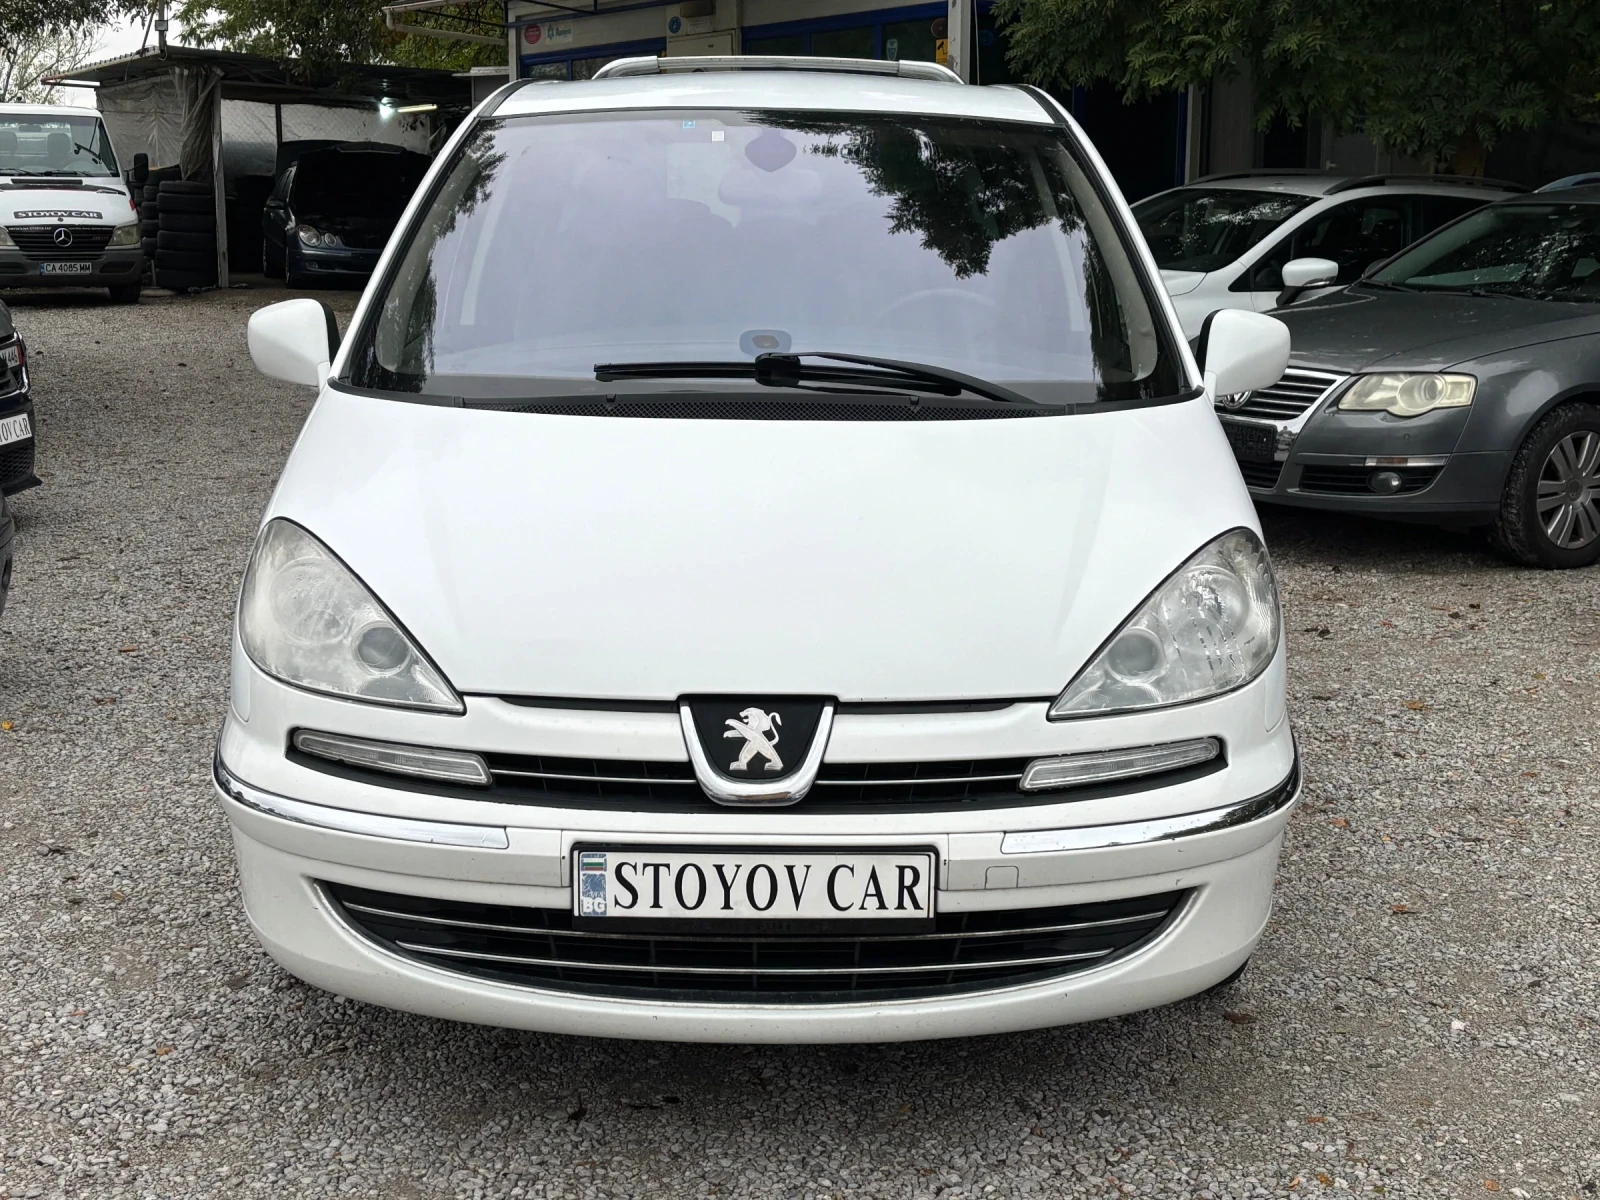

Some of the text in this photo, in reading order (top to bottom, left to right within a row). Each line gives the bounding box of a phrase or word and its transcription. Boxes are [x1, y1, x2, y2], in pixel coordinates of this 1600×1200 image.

[45, 263, 57, 273] CA
[79, 263, 91, 273] MM
[13, 417, 31, 438] CAR
[614, 861, 925, 912] STOYOV CAR
[582, 897, 607, 914] BG
